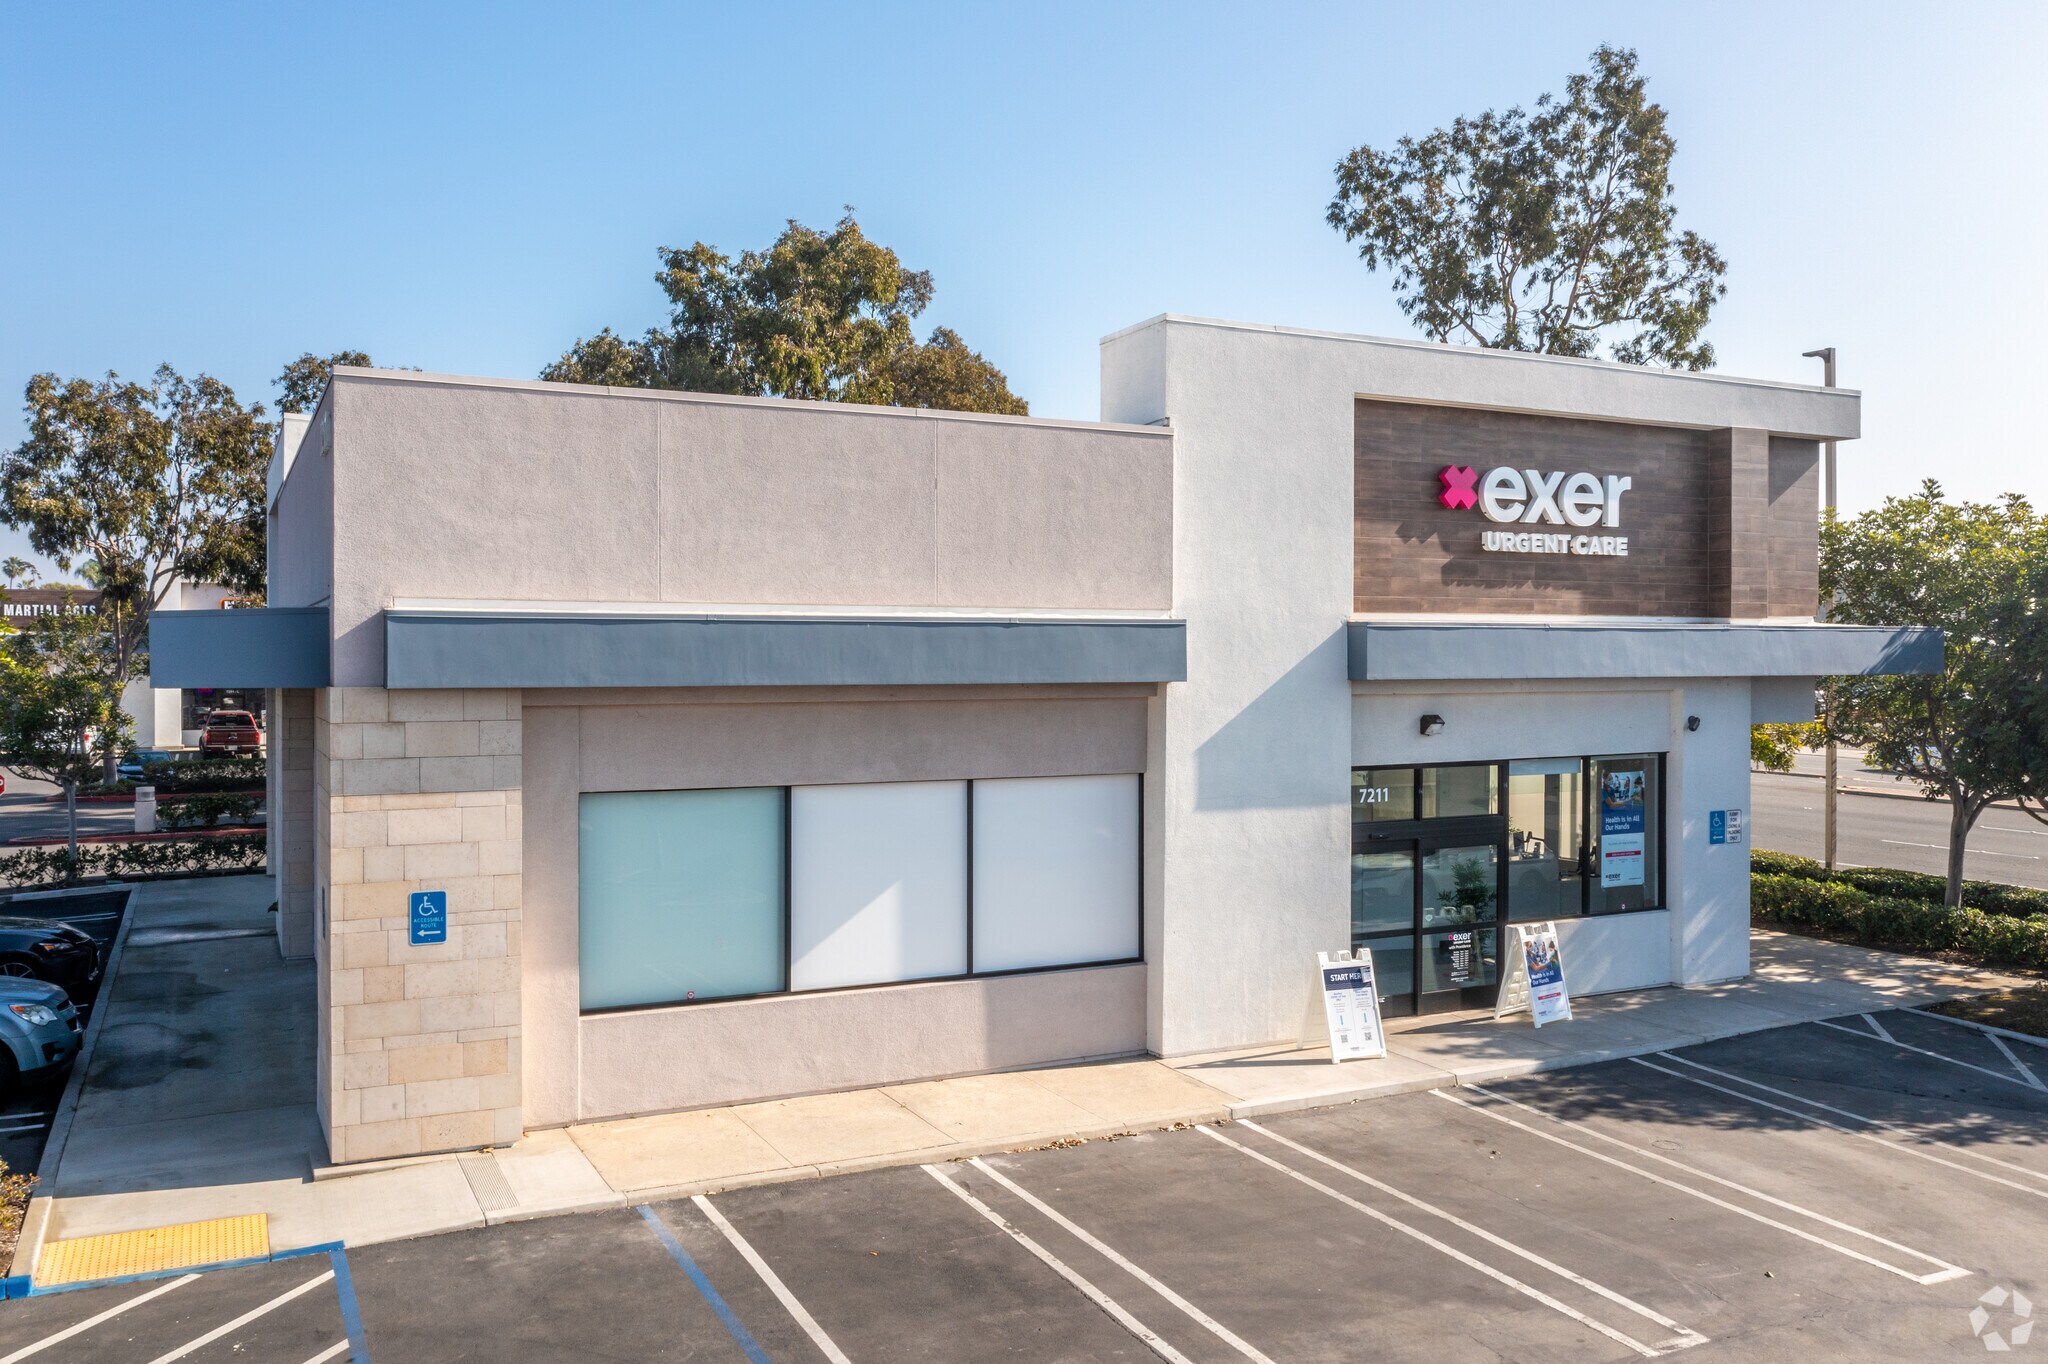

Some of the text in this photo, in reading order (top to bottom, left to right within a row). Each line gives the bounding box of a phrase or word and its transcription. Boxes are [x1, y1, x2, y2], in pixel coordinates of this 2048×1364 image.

[1478, 466, 1632, 528] exer
[1481, 531, 1629, 556] URGENT CARE
[1359, 787, 1389, 803] 7211
[1605, 815, 1620, 824] Health
[1621, 815, 1626, 823] is
[1627, 815, 1632, 823] in
[1453, 932, 1471, 940] exer
[1330, 972, 1362, 982] START HER
[1531, 972, 1543, 980] Health
